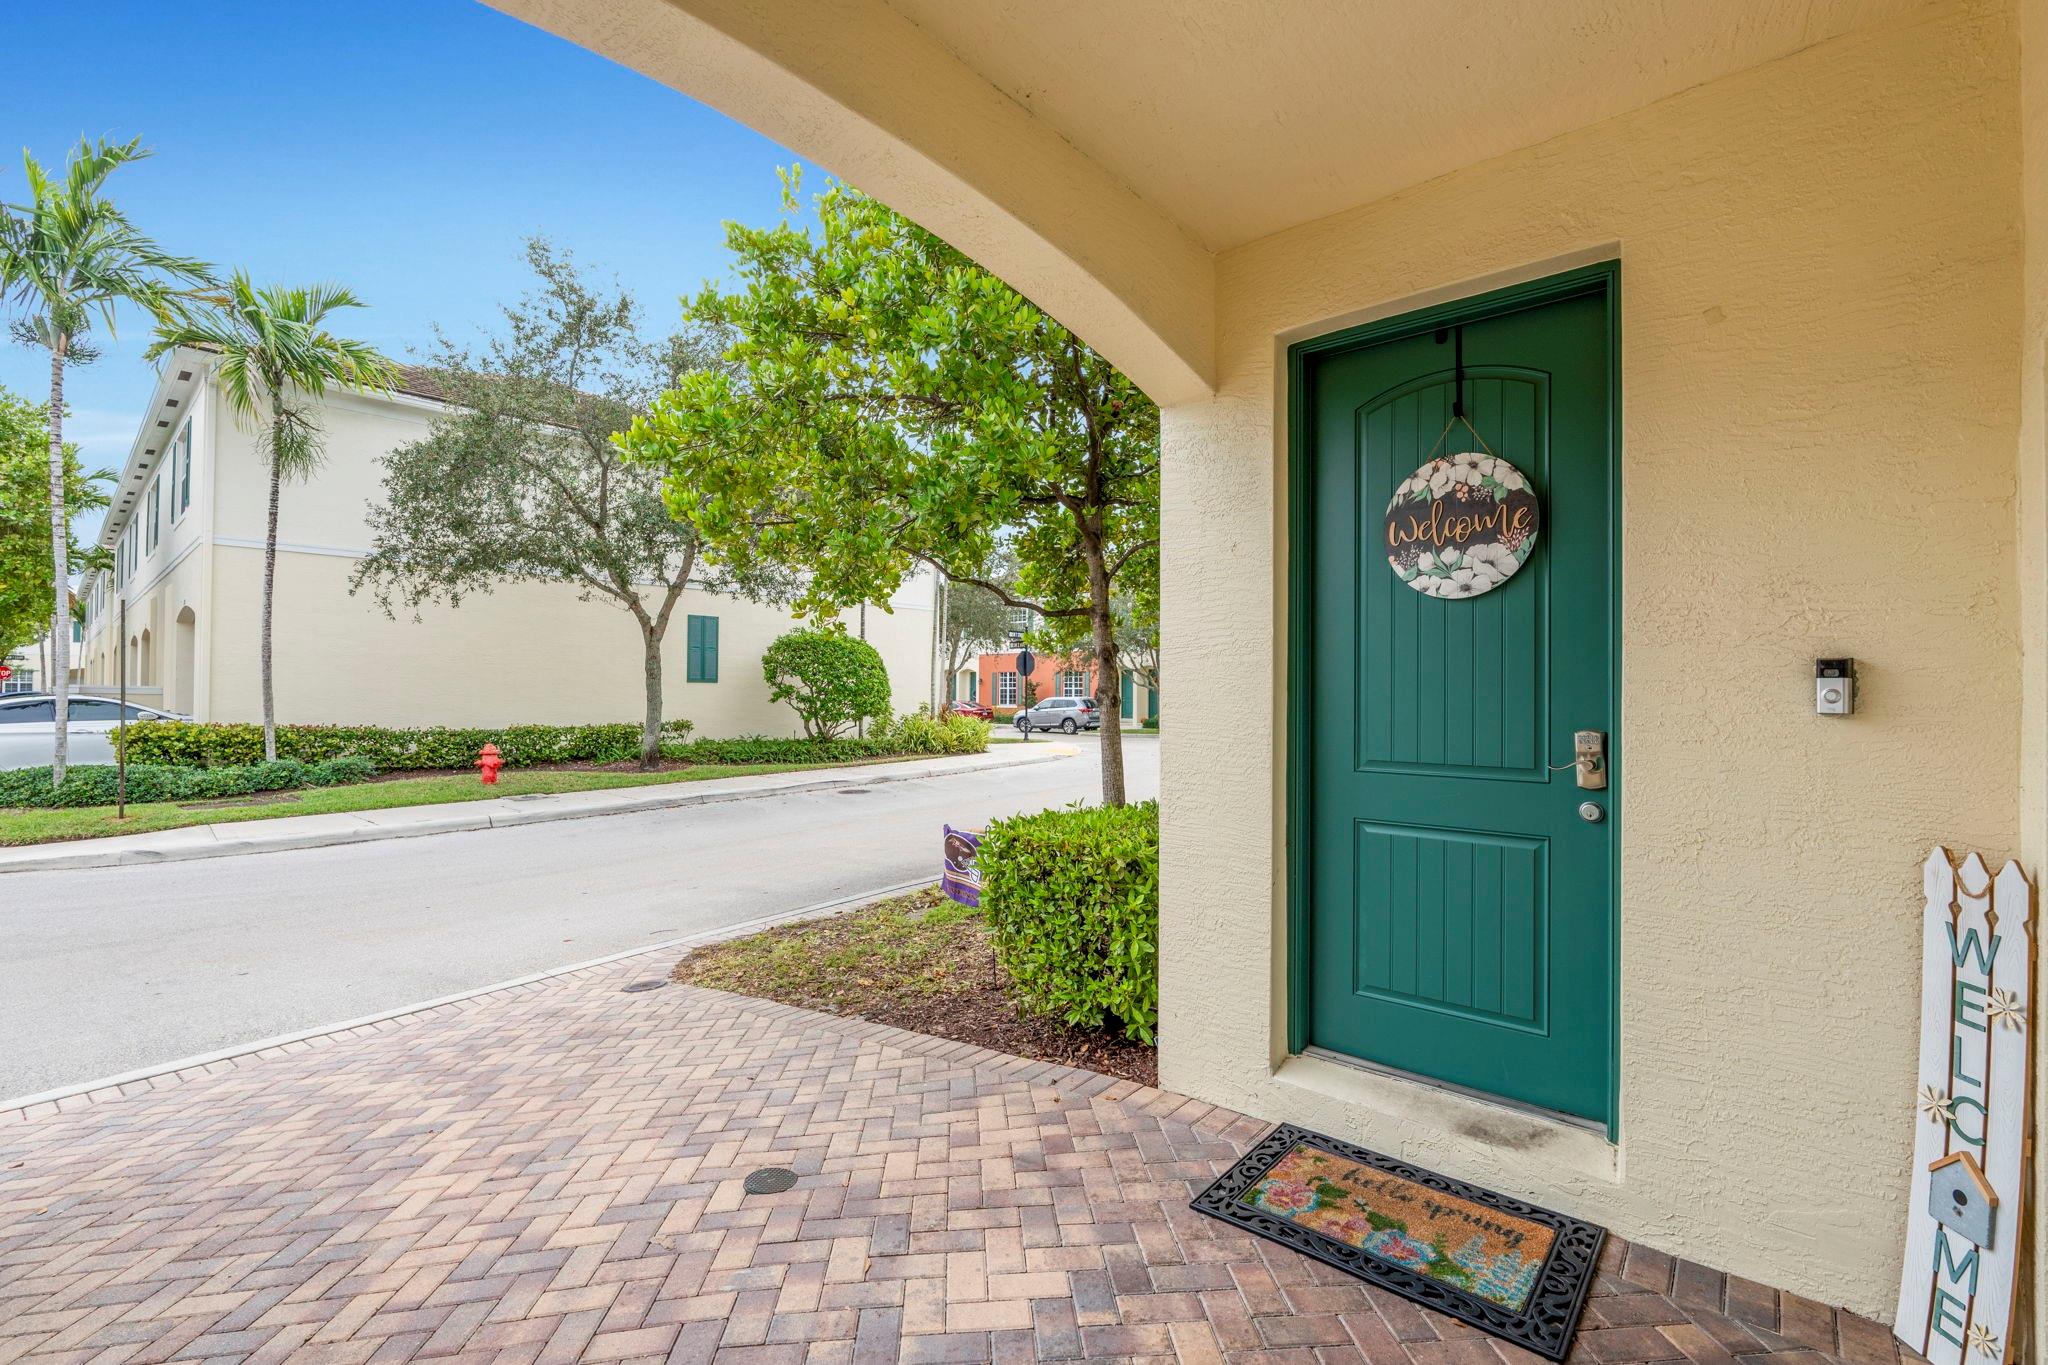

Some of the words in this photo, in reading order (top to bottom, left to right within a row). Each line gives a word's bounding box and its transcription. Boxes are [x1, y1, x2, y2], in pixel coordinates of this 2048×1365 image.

[1388, 500, 1532, 546] welcome
[1932, 920, 2002, 1349] WELCME
[1342, 1168, 1415, 1202] hello
[1422, 1199, 1525, 1249] spring
